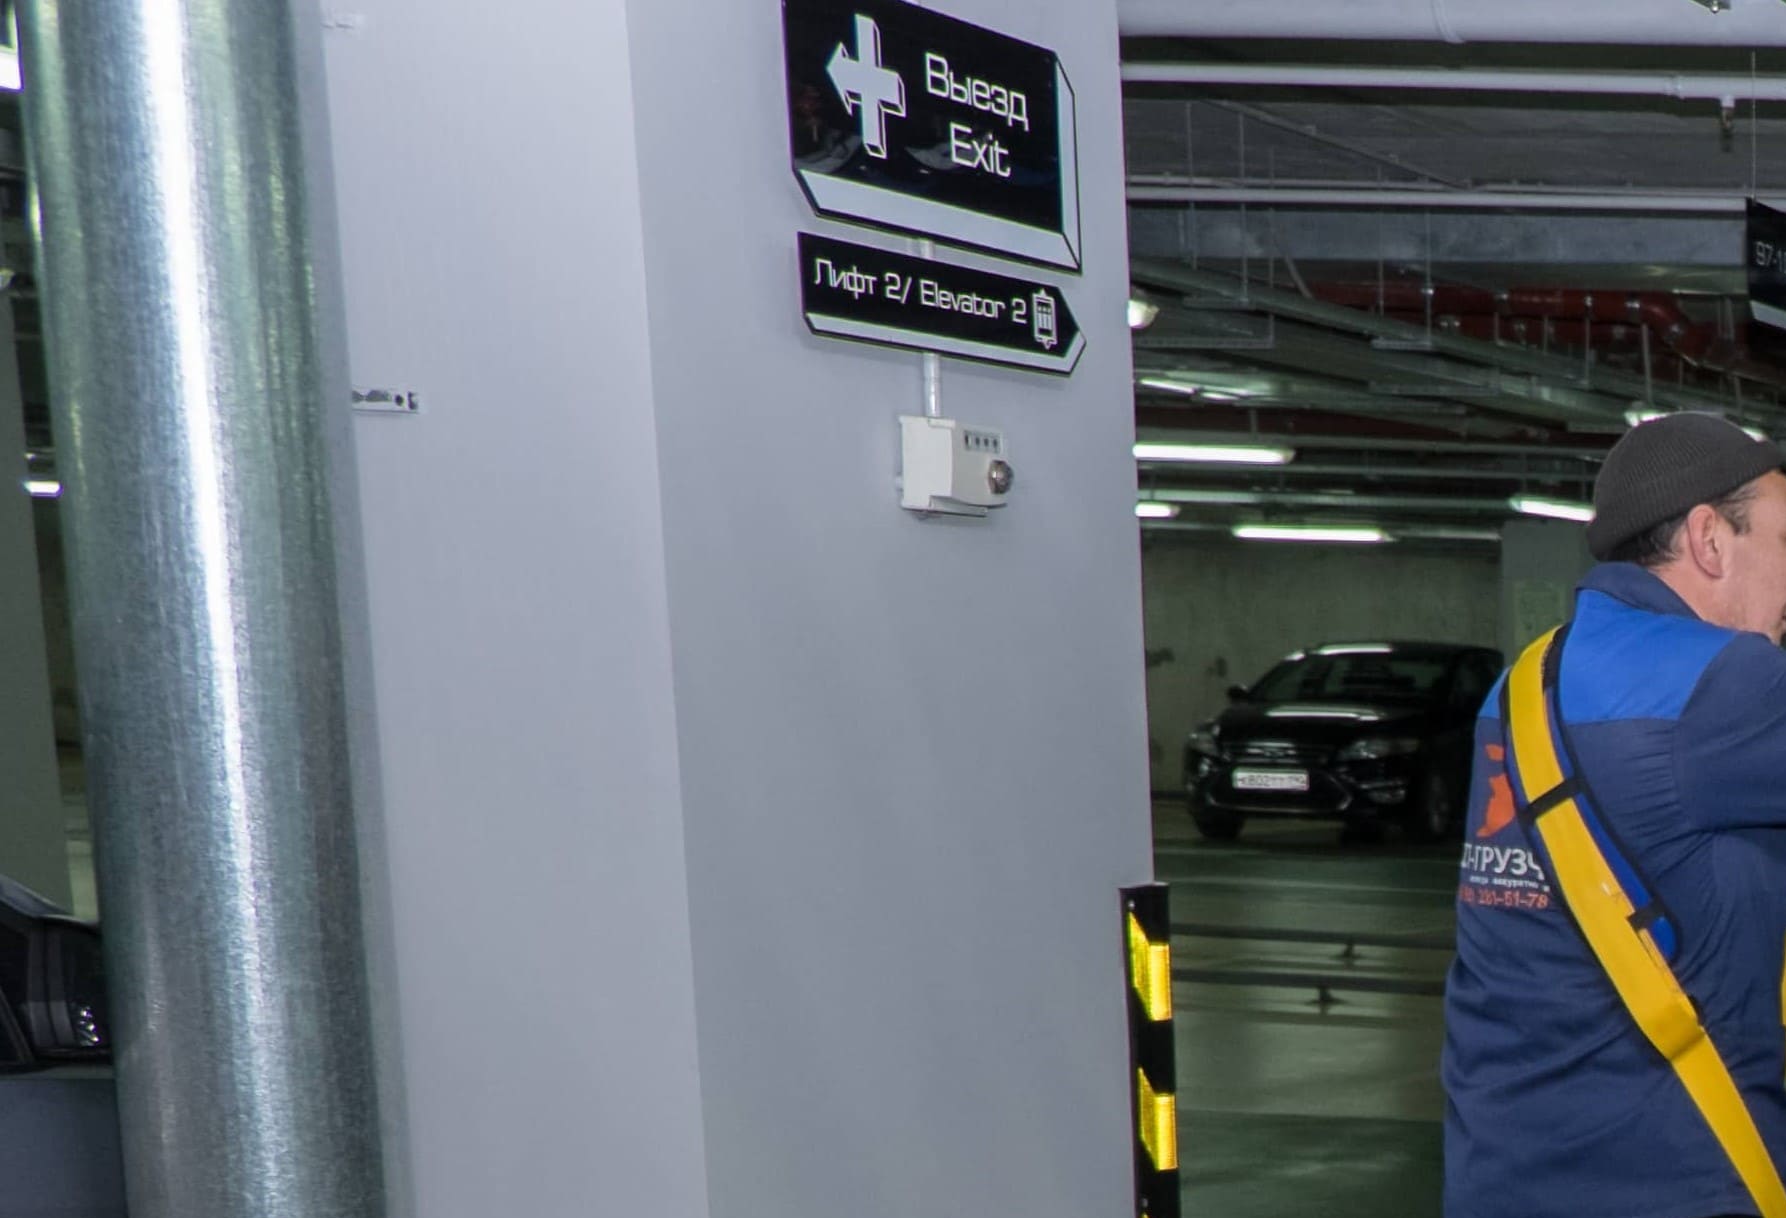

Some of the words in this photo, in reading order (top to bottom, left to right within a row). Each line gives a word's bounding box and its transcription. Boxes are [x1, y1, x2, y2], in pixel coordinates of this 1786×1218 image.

[925, 52, 1029, 132] Выезд
[950, 122, 1012, 178] Exit
[814, 257, 877, 300] Лифт
[920, 279, 1006, 319] Elevator
[1012, 298, 1028, 325] 2
